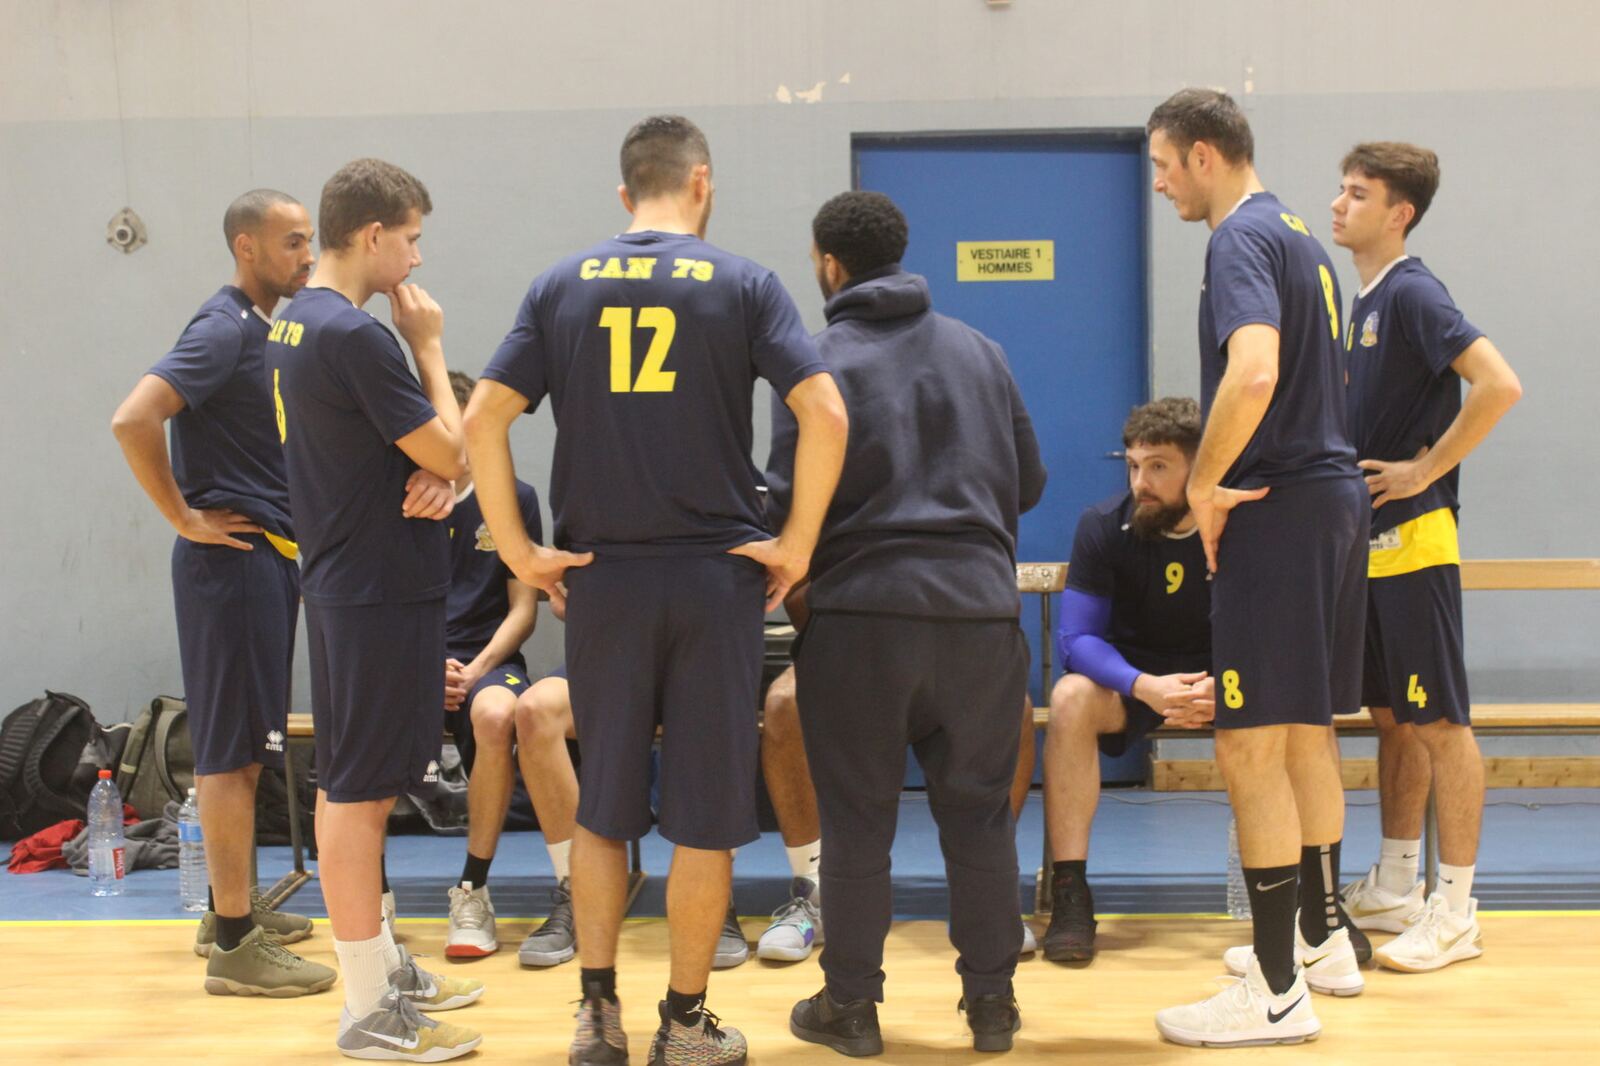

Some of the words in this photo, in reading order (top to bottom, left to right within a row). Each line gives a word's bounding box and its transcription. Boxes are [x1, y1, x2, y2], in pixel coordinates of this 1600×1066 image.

[579, 257, 657, 280] CAN
[671, 258, 714, 282] 79
[970, 247, 1031, 260] VESTIAIRE
[1035, 248, 1041, 258] 1
[977, 262, 1033, 274] HOMMES
[598, 306, 677, 393] 12
[1165, 561, 1185, 595] 9
[1222, 669, 1244, 709] 8
[1407, 673, 1427, 709] 4
